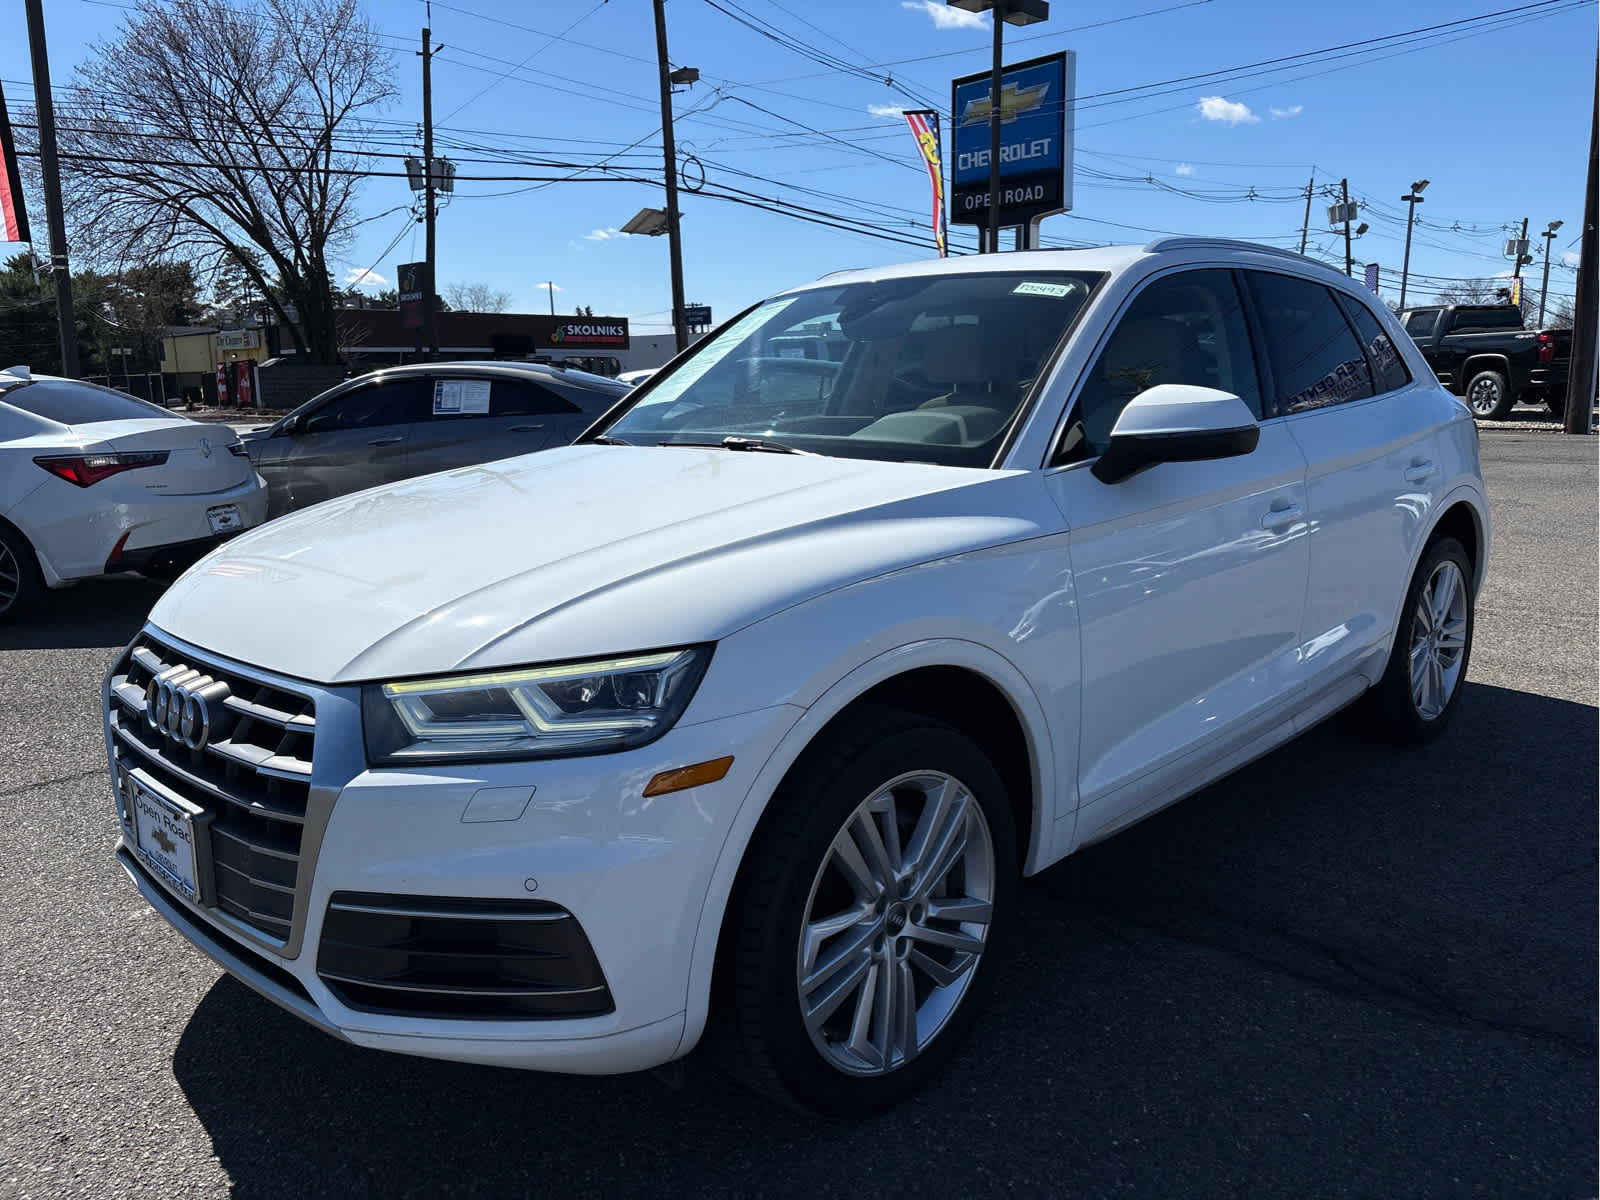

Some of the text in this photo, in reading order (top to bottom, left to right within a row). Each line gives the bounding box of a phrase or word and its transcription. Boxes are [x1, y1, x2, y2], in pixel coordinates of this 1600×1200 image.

[958, 138, 1052, 170] CHEROLET
[965, 185, 1044, 210] OPE ROAD
[567, 325, 624, 336] SKOLNIKS
[135, 795, 161, 822] Open
